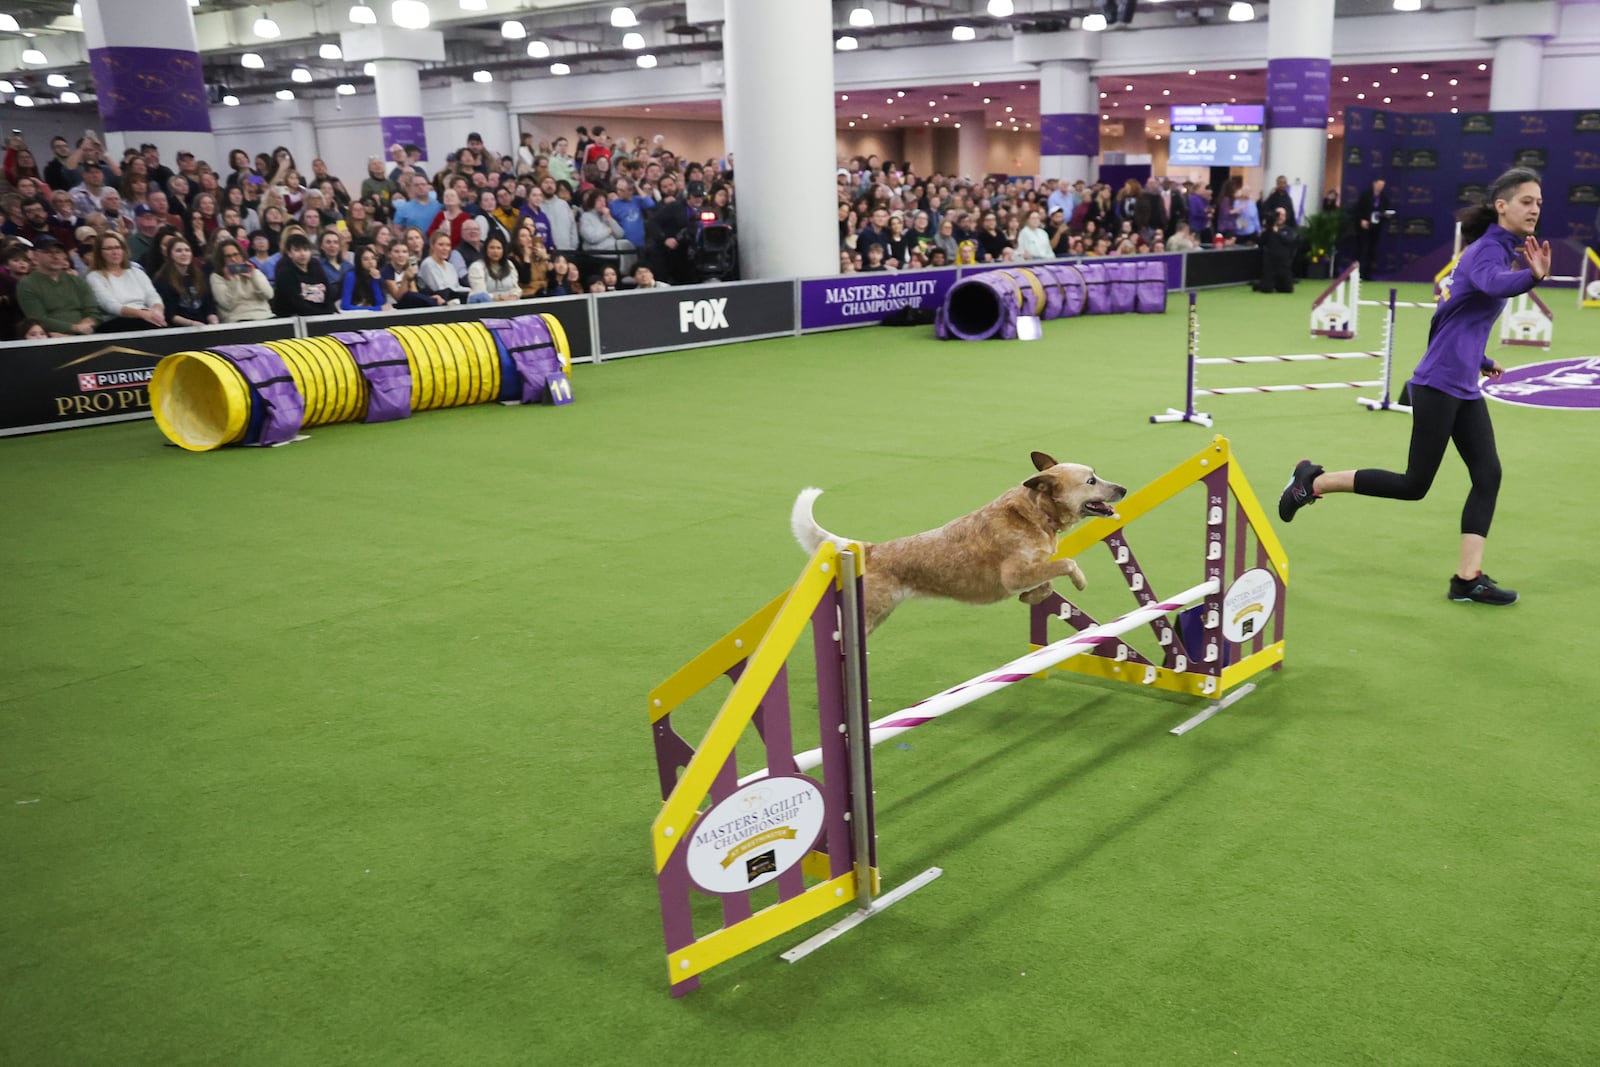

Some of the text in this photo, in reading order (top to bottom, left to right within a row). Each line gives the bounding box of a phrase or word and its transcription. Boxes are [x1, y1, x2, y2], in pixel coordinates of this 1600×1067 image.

[1177, 138, 1249, 154] 23.44 0
[825, 280, 937, 304] MASTERS AGILITY
[679, 297, 729, 333] FOX
[98, 371, 153, 385] PURINA
[550, 379, 571, 401] 11
[55, 389, 150, 416] PRO PL
[1211, 496, 1222, 504] 24
[1110, 539, 1120, 547] 24
[1209, 568, 1220, 576] 16
[695, 790, 812, 847] MASTERS AGILITY
[714, 807, 800, 850] CHAMPIONSHIP
